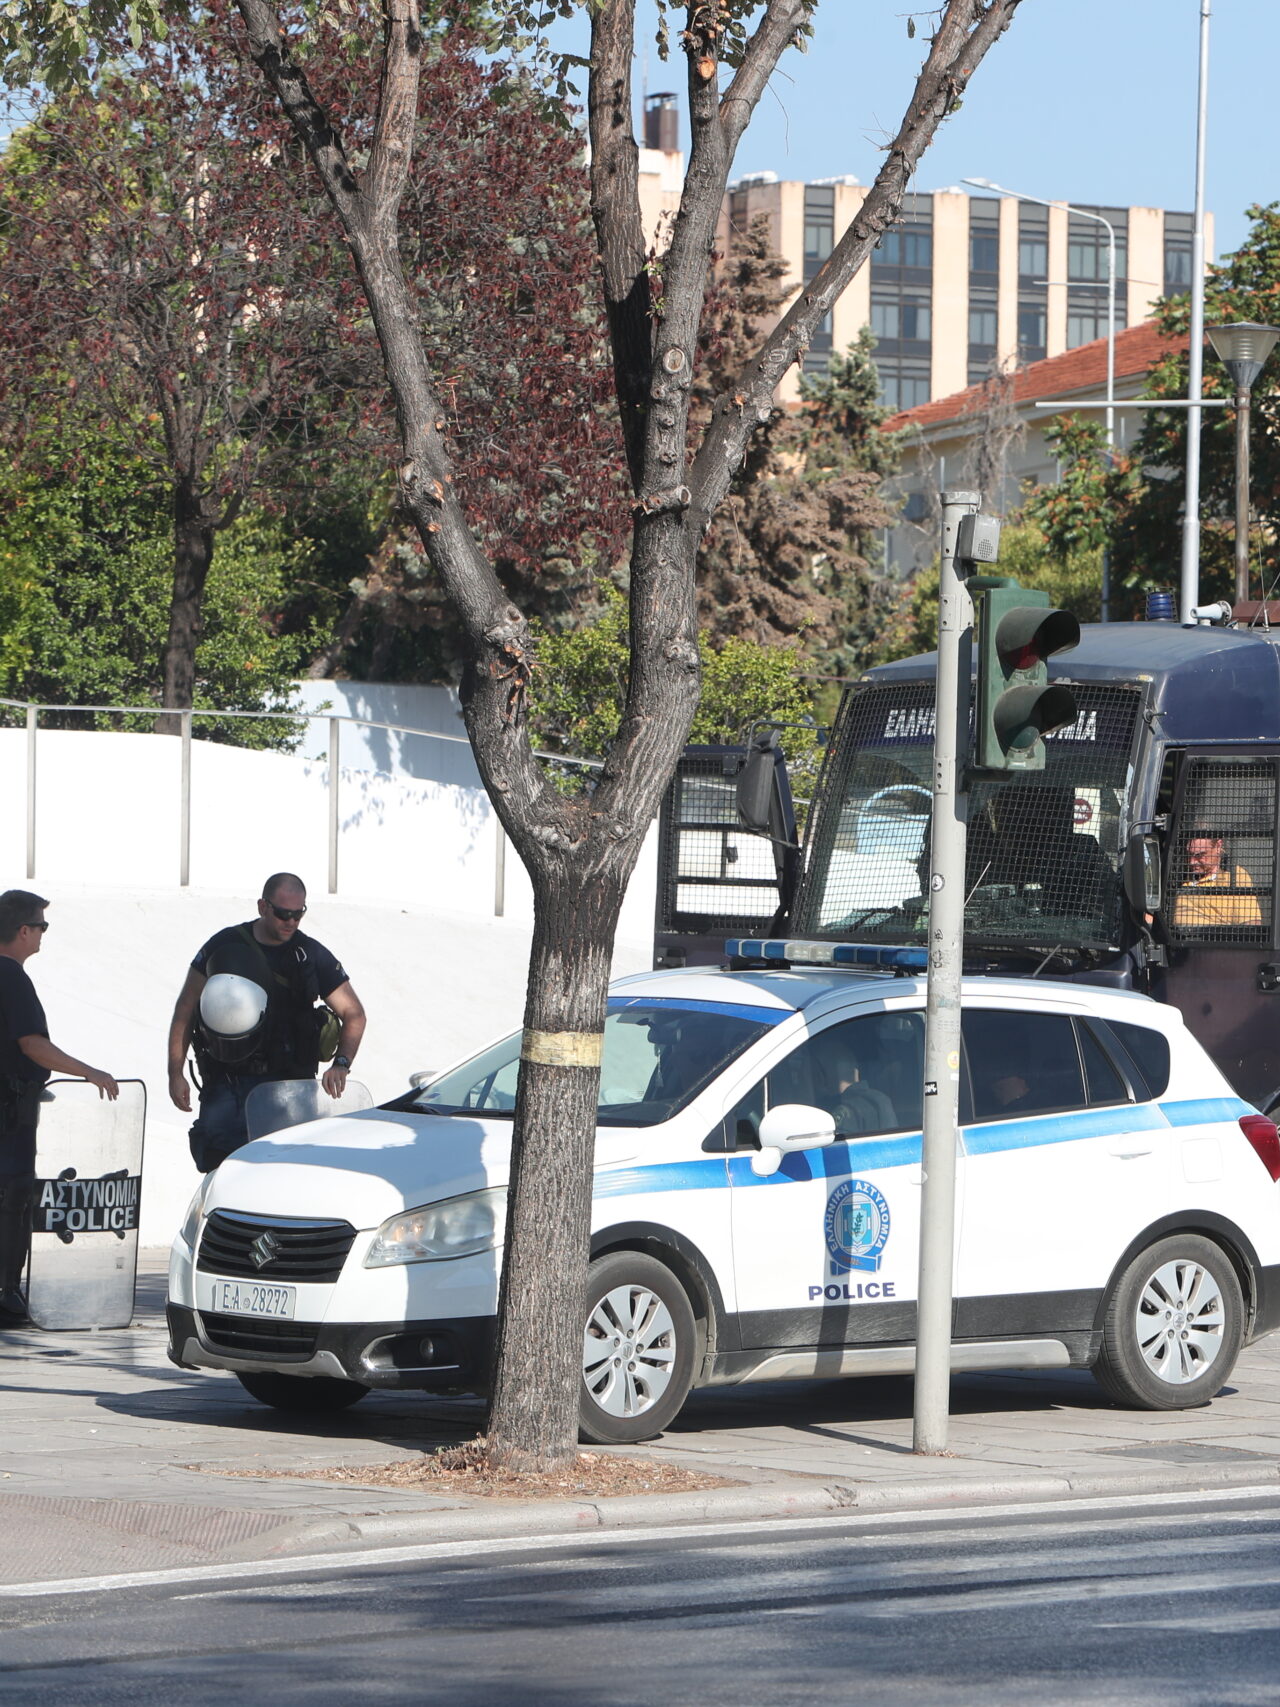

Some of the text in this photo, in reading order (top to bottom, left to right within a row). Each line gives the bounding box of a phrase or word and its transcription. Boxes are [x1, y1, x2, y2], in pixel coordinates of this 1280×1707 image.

[40, 1179, 138, 1209] ΑΣΤΥΝΟΜΙΑ
[45, 1206, 135, 1231] POLICE
[826, 1180, 890, 1252] ΕΛΛΗΝΙΚΗ ΑΣΤΥΝΟΜΙΑ
[251, 1287, 289, 1315] 28272
[808, 1282, 896, 1301] POLICE
